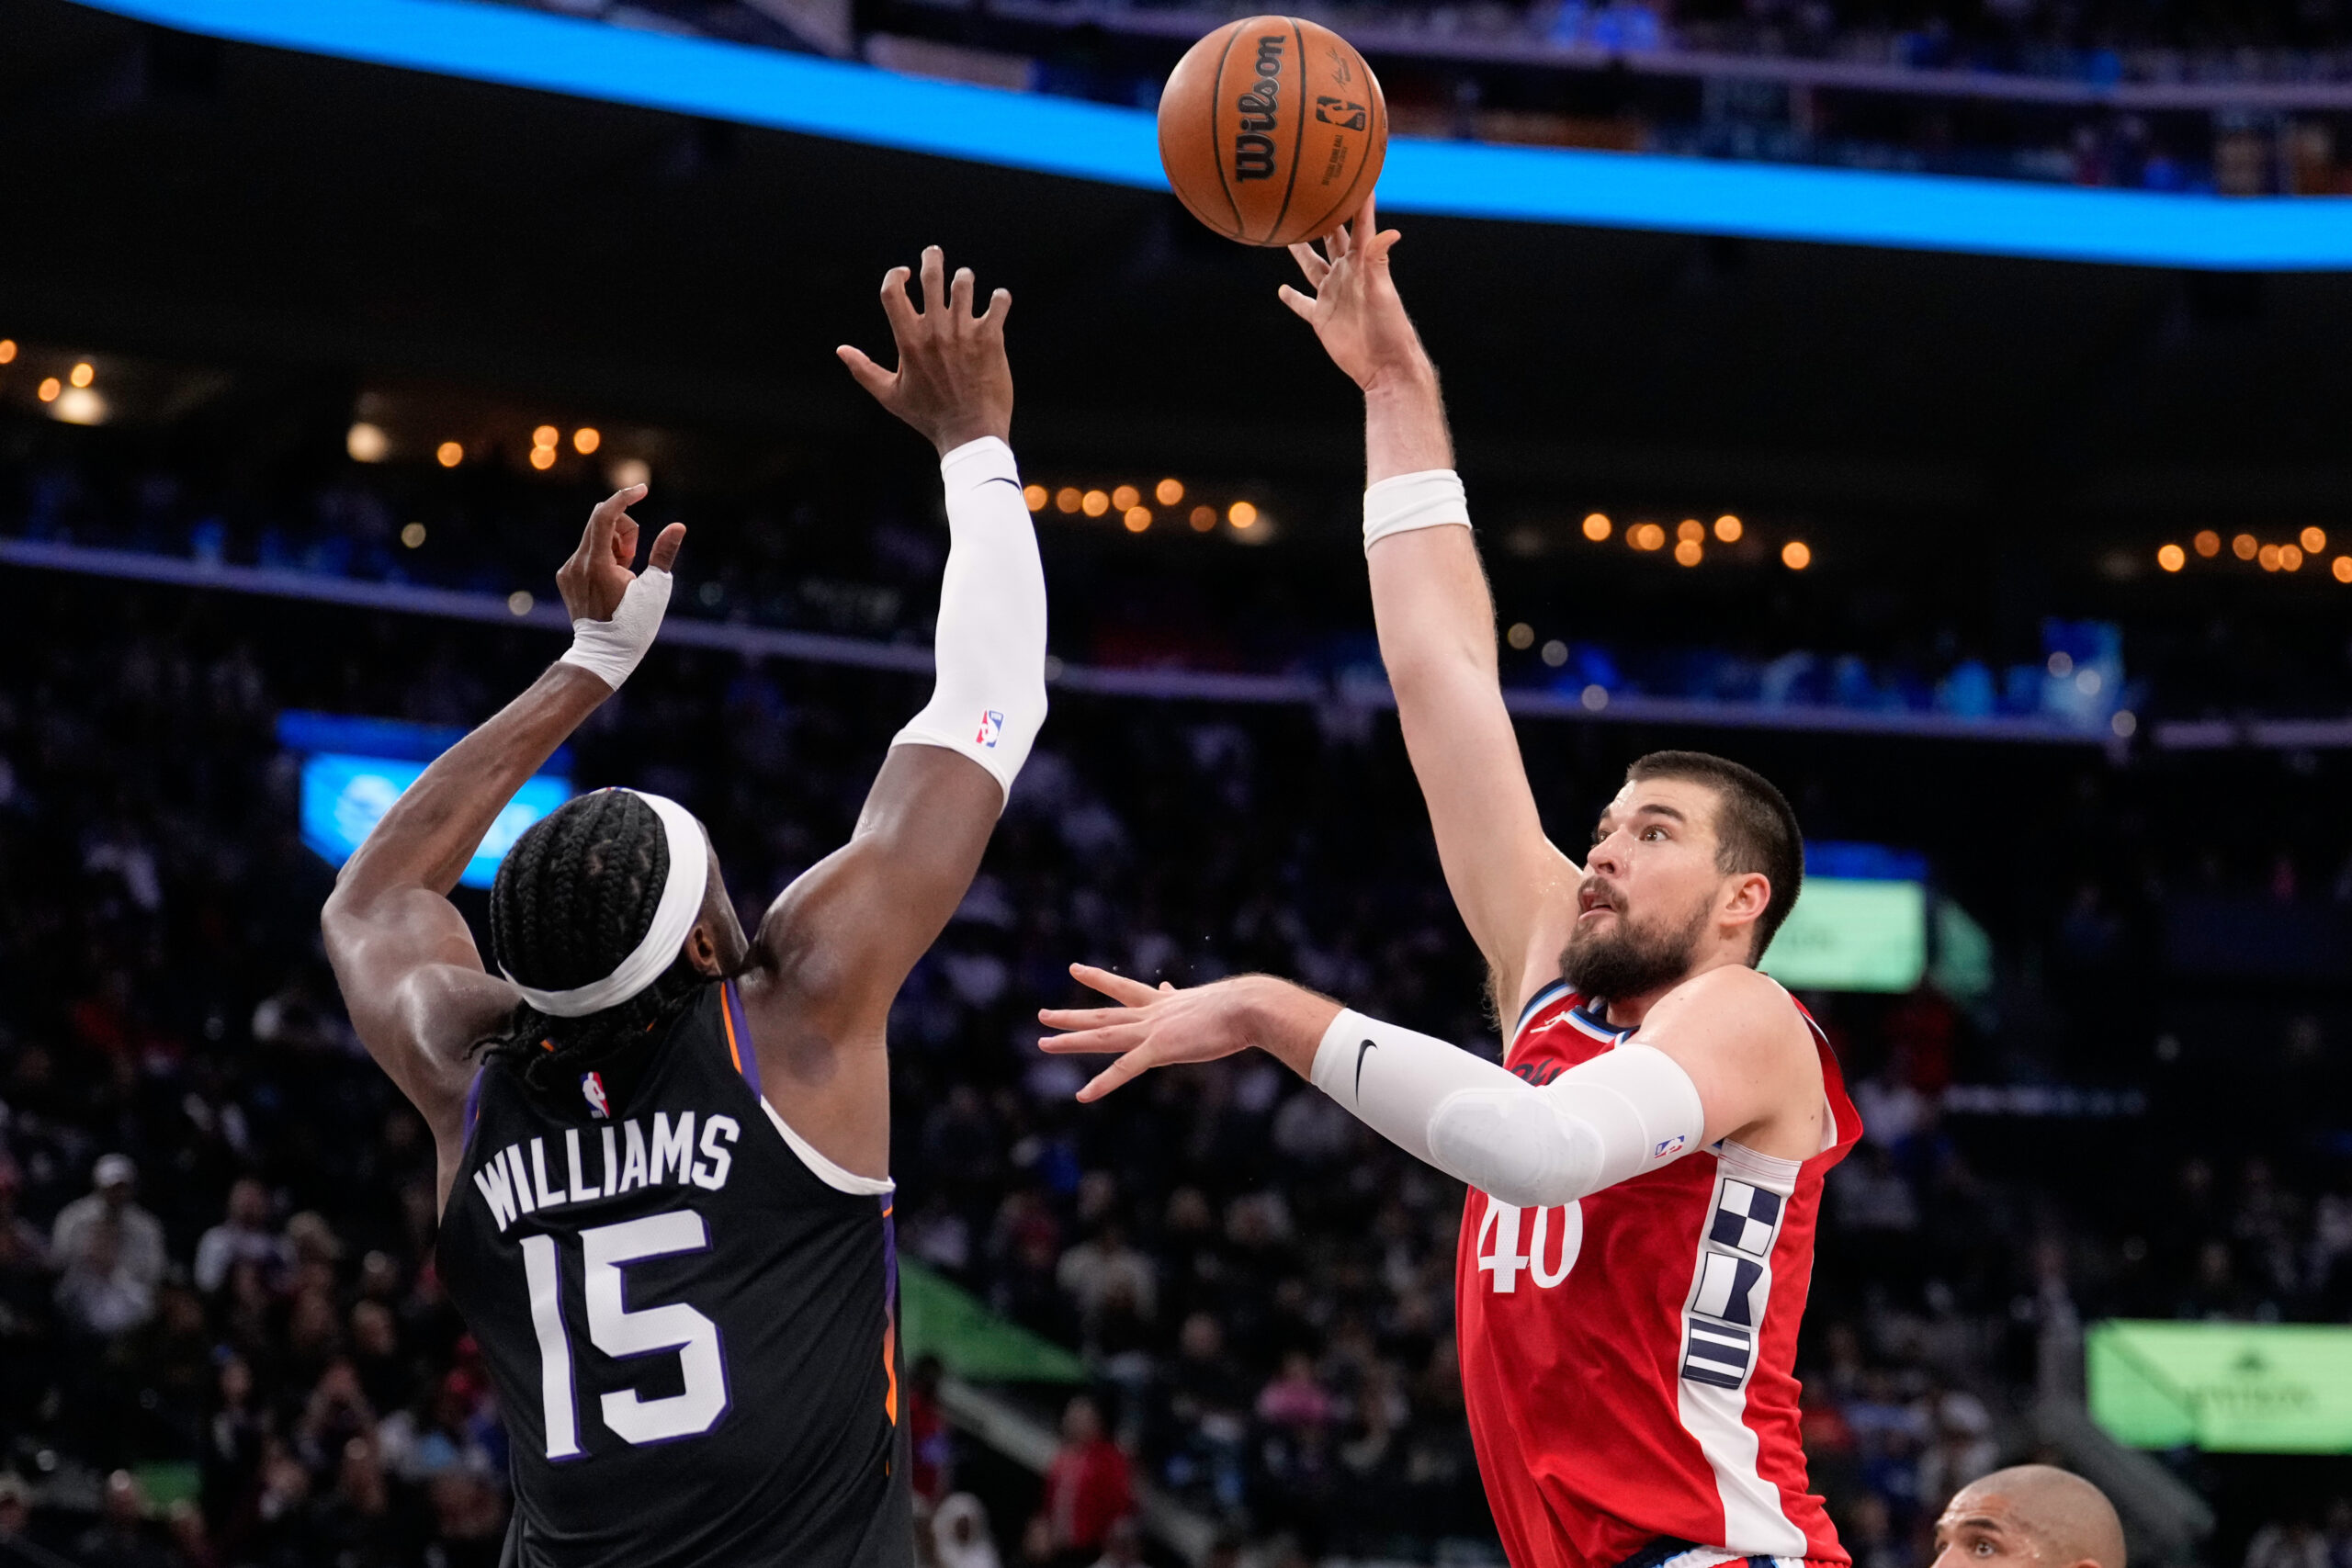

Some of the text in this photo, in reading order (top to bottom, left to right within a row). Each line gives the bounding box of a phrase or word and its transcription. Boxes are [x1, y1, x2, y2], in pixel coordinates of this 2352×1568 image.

[1235, 35, 1287, 183] Wilson
[473, 1111, 741, 1233] WILLIAMS
[1477, 1193, 1584, 1293] 40
[519, 1209, 732, 1461] 15
